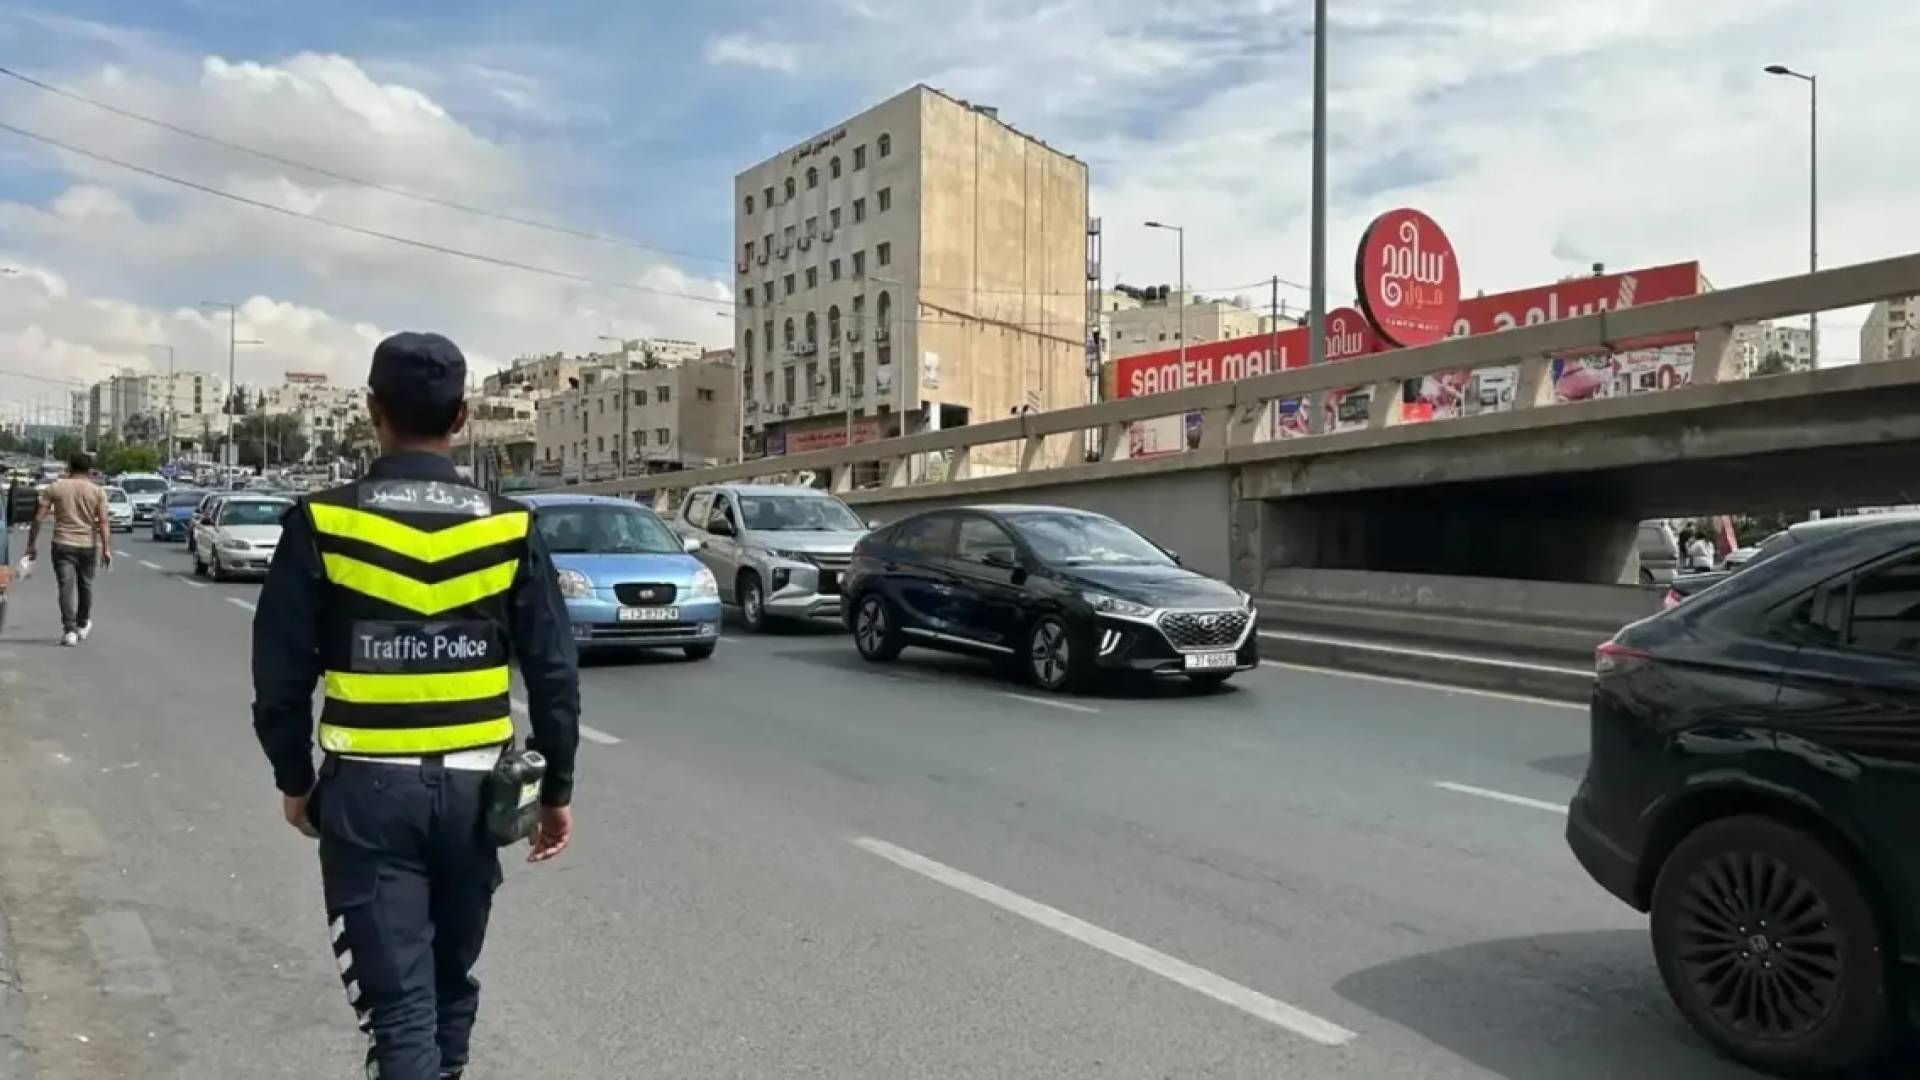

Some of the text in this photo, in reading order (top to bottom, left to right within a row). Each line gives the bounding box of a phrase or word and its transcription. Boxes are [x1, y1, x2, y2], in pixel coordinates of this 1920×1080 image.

[1380, 220, 1443, 307] سامح
[1405, 281, 1443, 309] مول
[1131, 346, 1288, 398] SAMEH MALL
[365, 481, 487, 511] شرطة السير
[360, 634, 487, 659] Traffic Police
